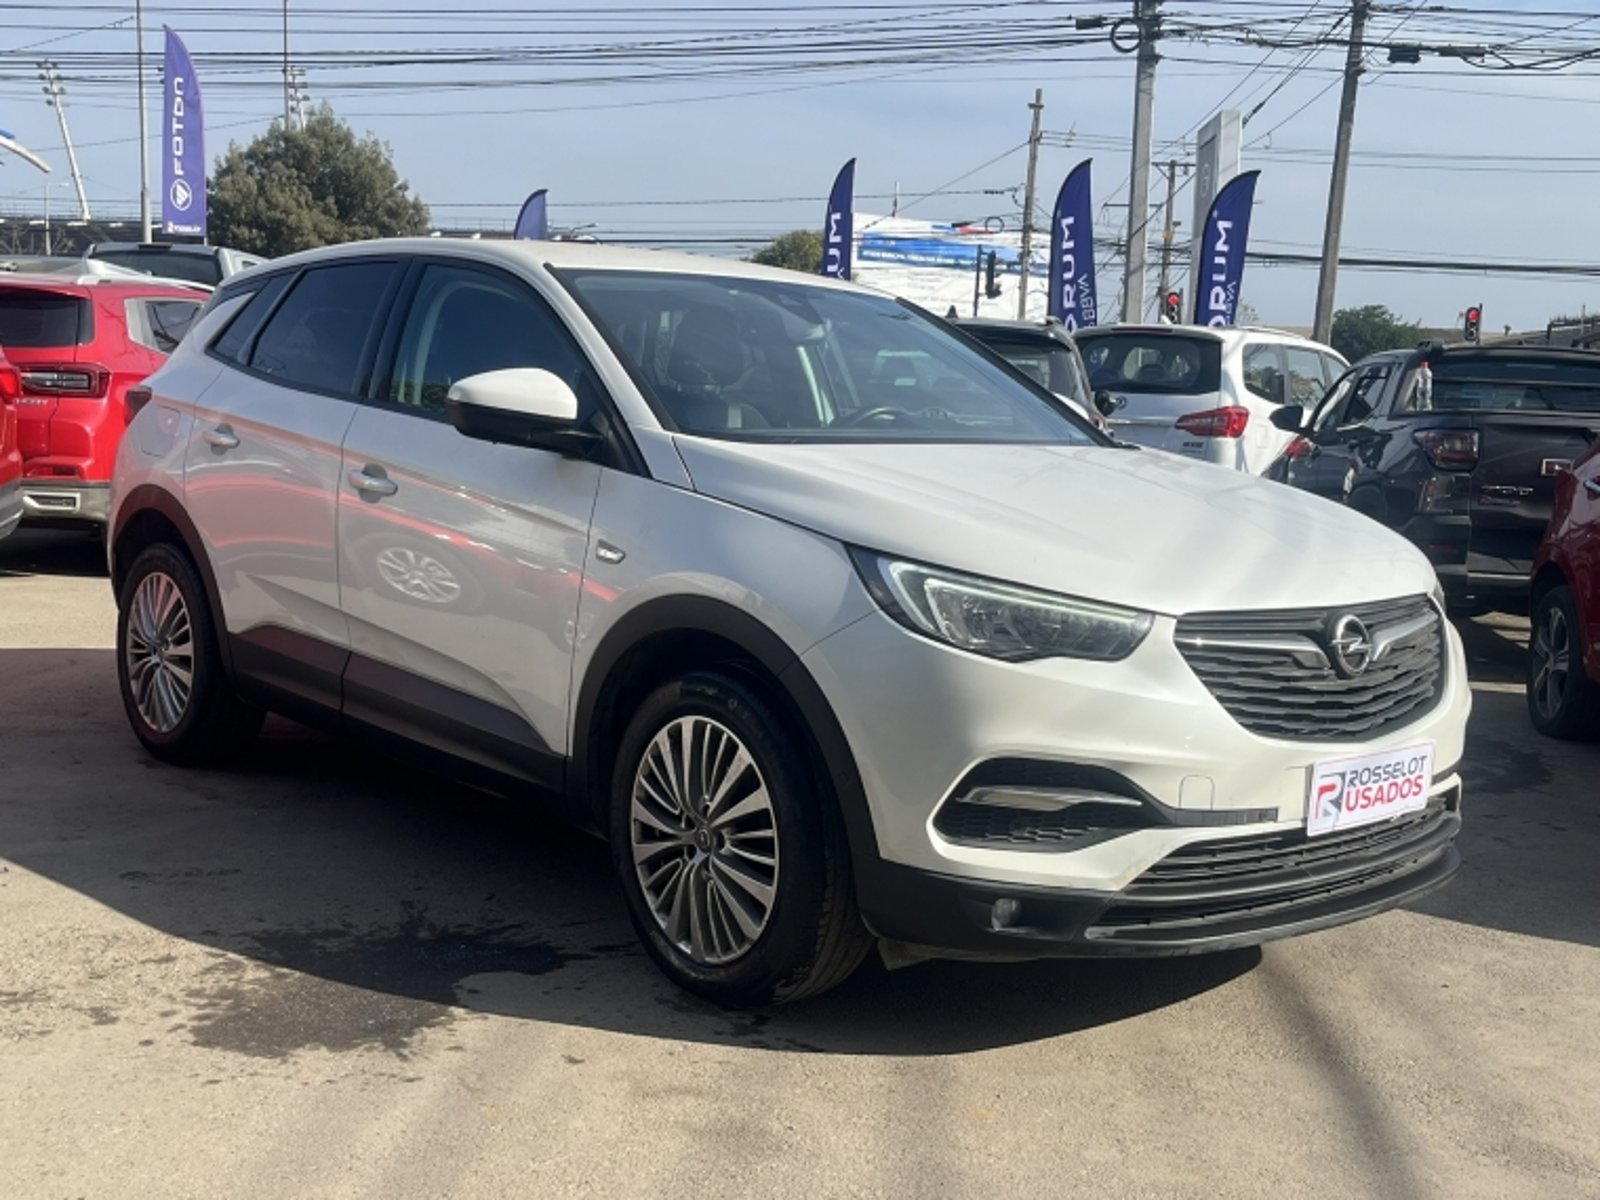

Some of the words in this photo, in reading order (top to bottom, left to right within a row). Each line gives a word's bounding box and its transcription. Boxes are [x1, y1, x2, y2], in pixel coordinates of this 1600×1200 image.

[172, 77, 185, 176] FOTON
[1347, 755, 1427, 788] ROSSELOT
[1345, 774, 1424, 811] USADOS
